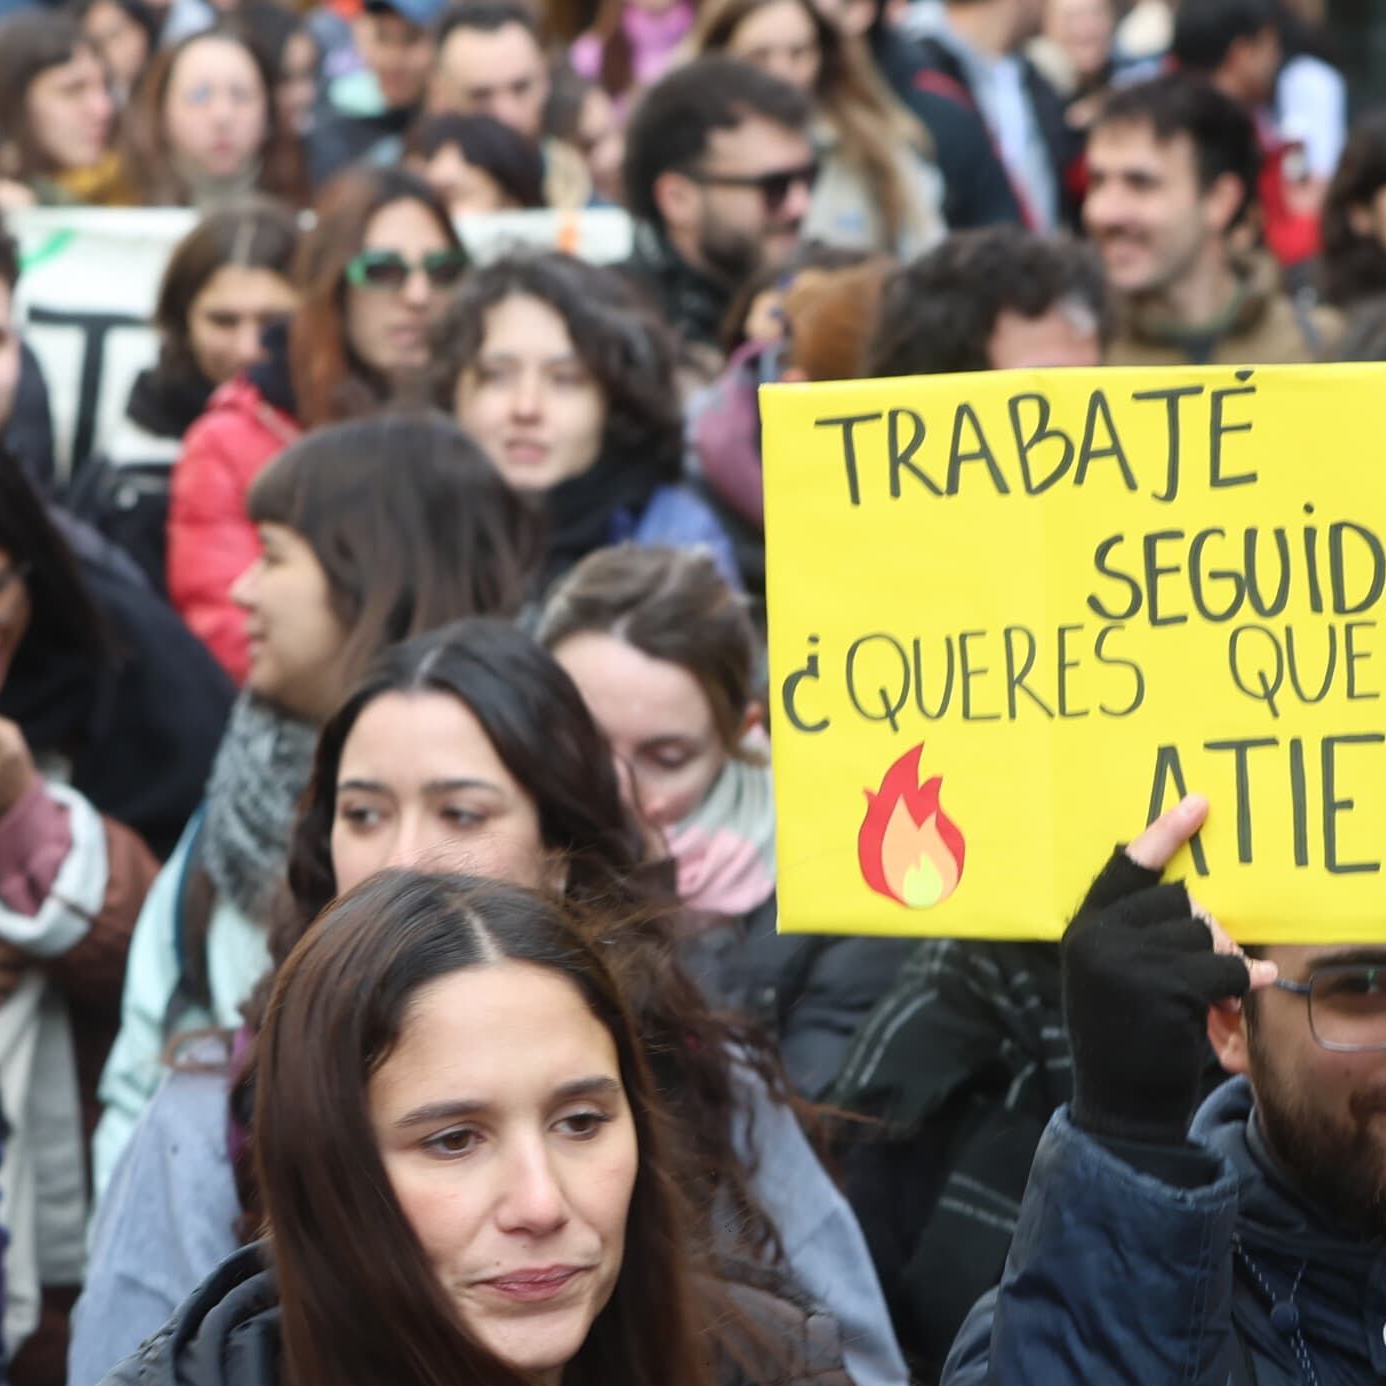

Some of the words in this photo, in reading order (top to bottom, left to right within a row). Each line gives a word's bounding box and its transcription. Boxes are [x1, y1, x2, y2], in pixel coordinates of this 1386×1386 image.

[815, 369, 1258, 506] TRABAJÉ
[781, 623, 1145, 733] ¿QUERES
[1229, 620, 1381, 719] QUE
